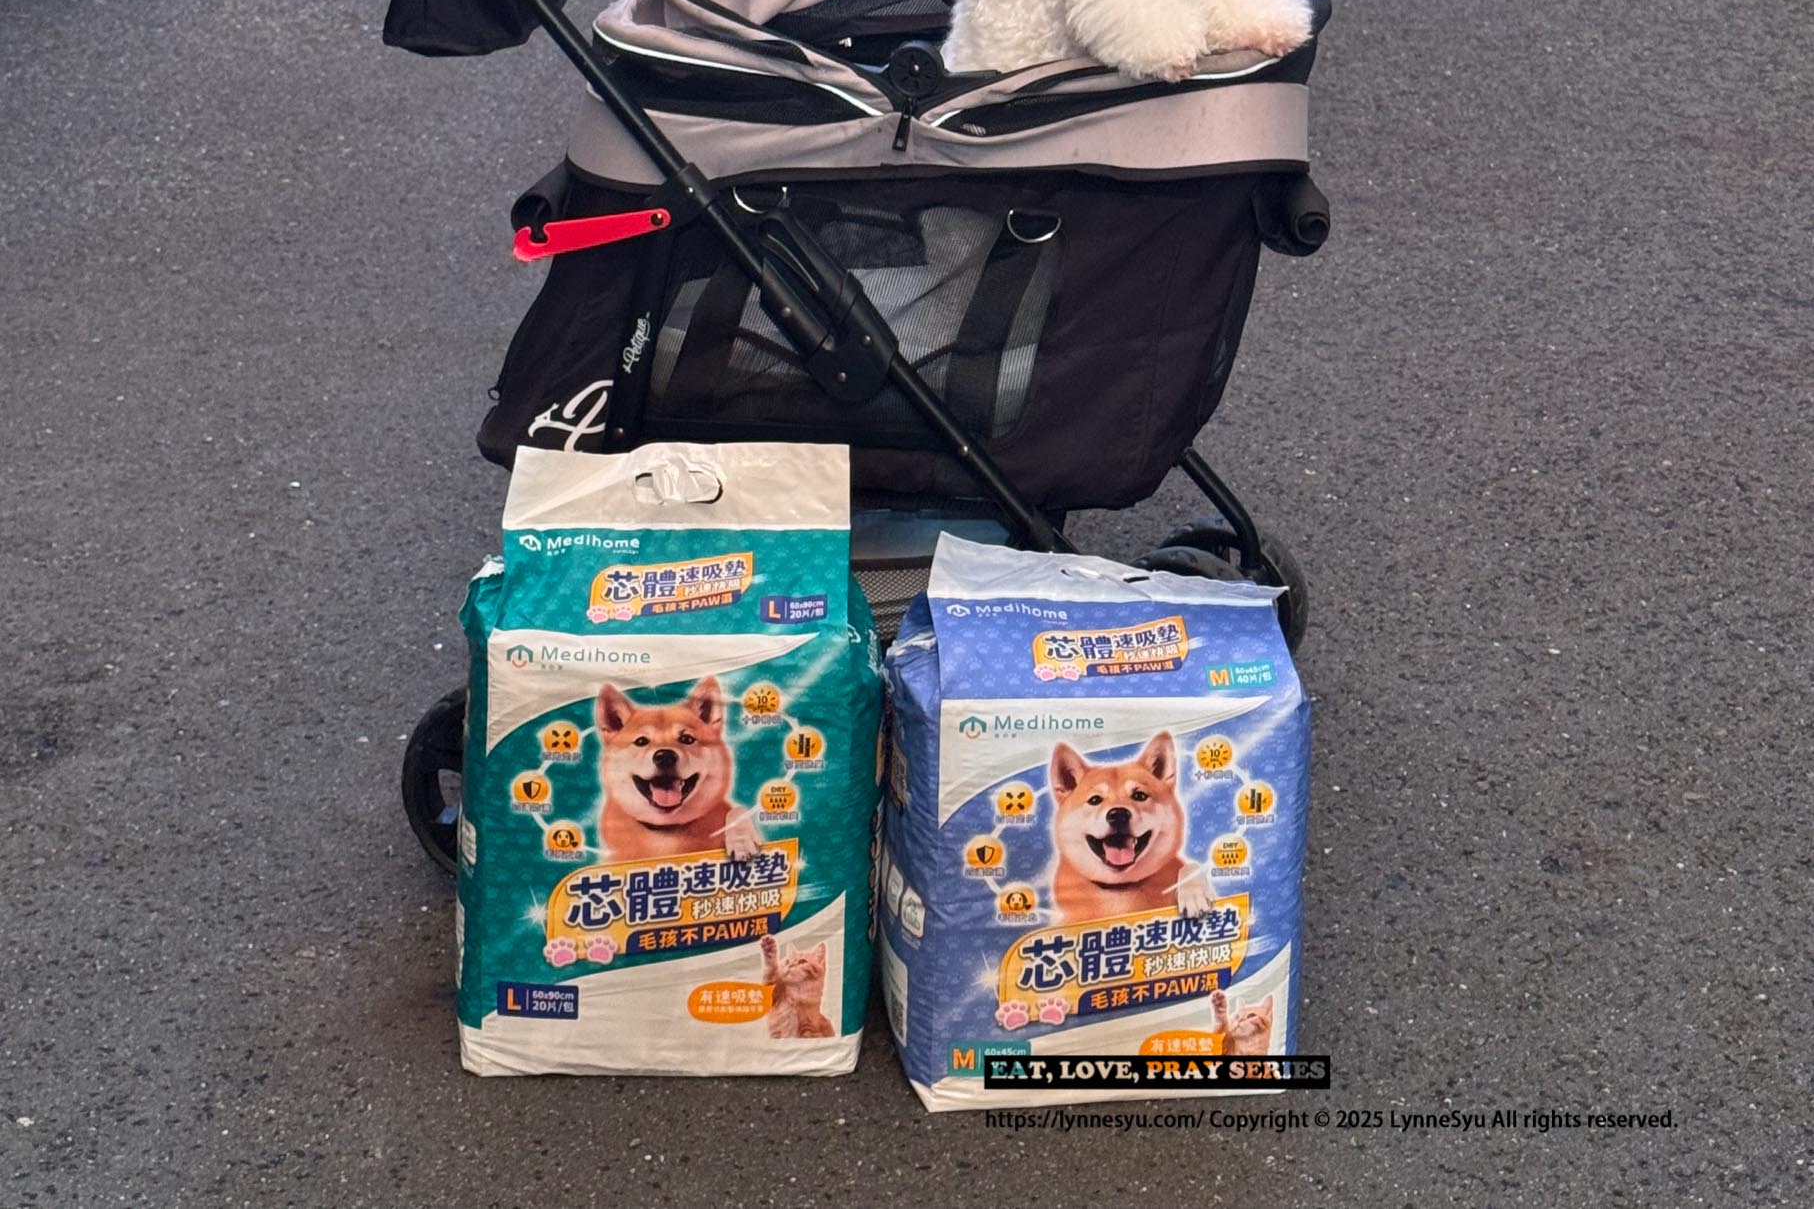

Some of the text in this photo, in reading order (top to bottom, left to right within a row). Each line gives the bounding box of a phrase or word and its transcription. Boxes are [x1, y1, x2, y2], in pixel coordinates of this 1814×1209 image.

[546, 533, 641, 551] Medihome
[603, 558, 747, 601] 芯體速吸墊
[768, 600, 781, 619] L
[975, 602, 1068, 620] Medihome
[1043, 622, 1180, 661] 芯體速吸墊
[541, 645, 651, 663] Medihome
[1209, 668, 1230, 687] M
[757, 695, 768, 705] 10
[994, 714, 1105, 731] Medihome
[1209, 748, 1221, 758] 10
[1223, 841, 1239, 849] DRY
[567, 850, 789, 928] 芯體速吸墊
[691, 889, 781, 920] 秒速快吸
[1019, 906, 1241, 991] 芯體速吸墊
[1144, 946, 1232, 978] 秒速快吸
[507, 987, 522, 1011] L
[532, 990, 575, 1000] 60x90cm
[532, 1000, 575, 1015] 20片/包
[952, 1047, 975, 1070] M
